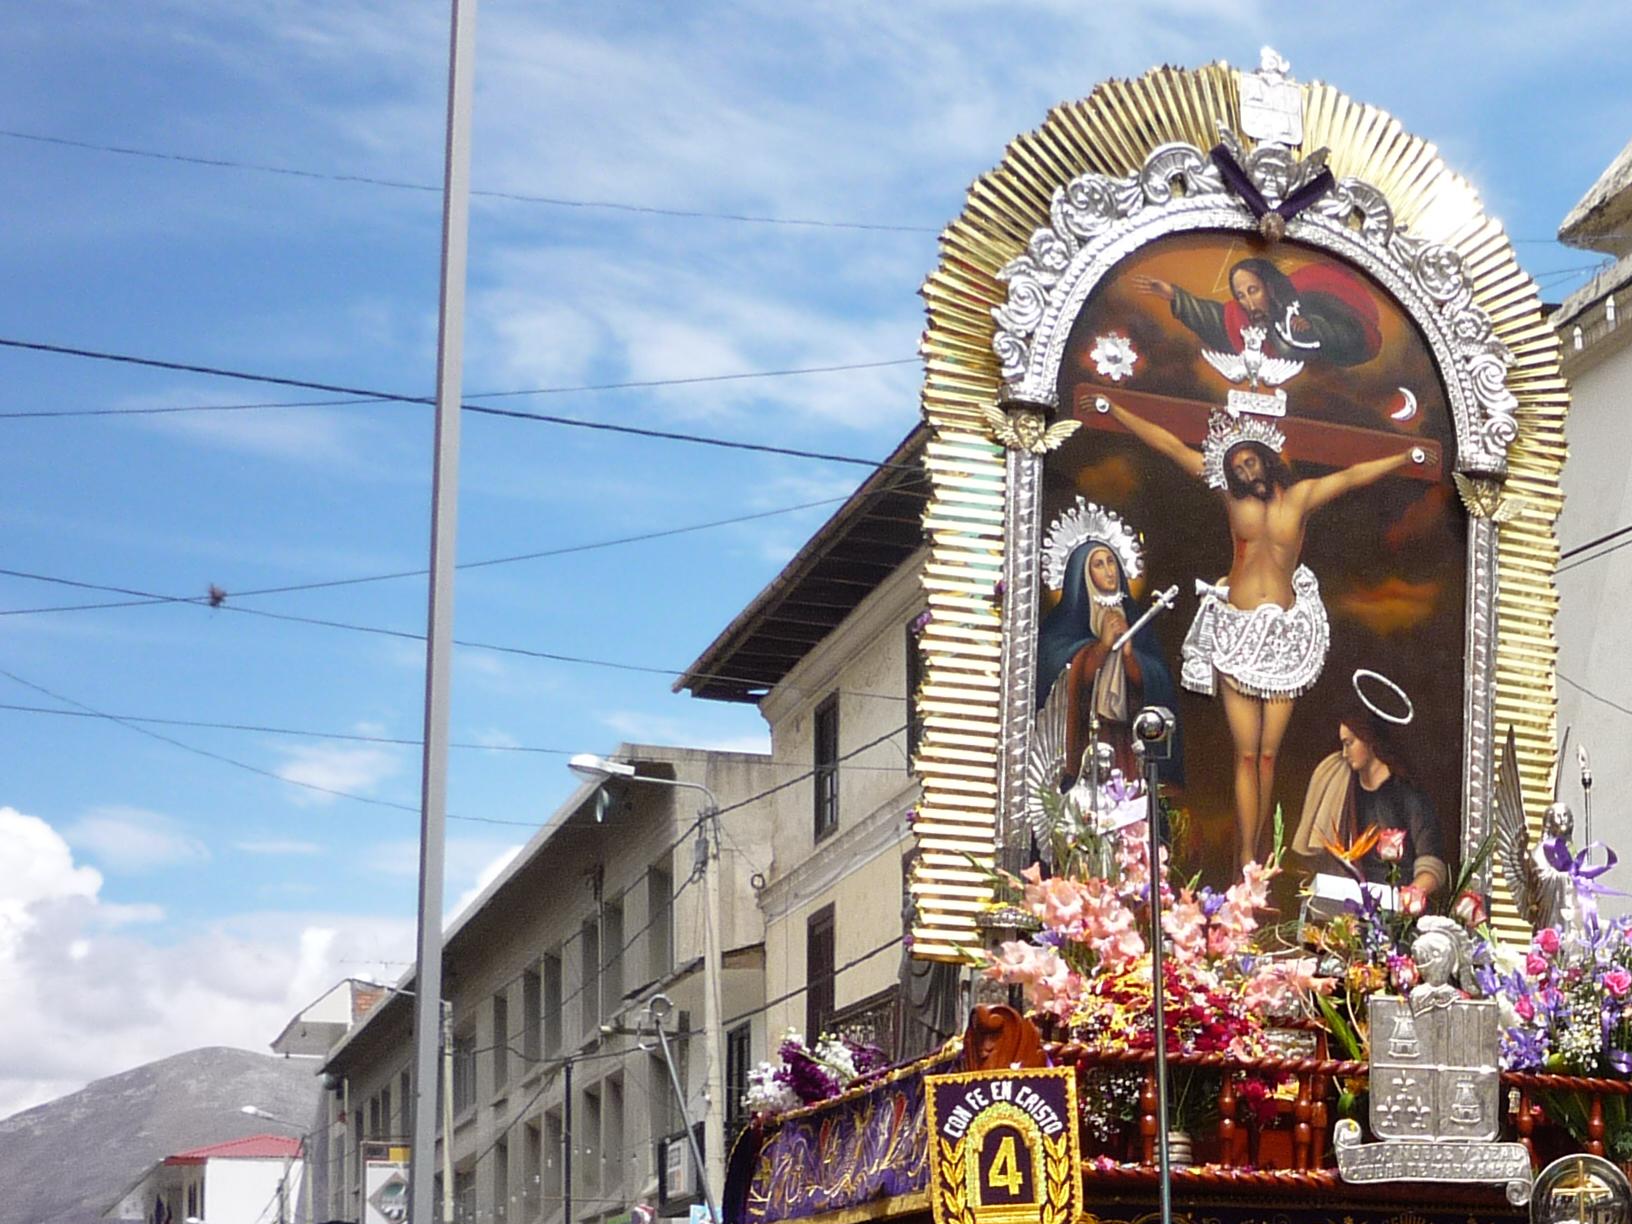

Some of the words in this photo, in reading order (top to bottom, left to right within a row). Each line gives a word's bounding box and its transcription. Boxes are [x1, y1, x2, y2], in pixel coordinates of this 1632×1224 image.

[943, 1105, 973, 1138] CON
[964, 1088, 989, 1110] FE
[990, 1081, 1012, 1101] EN
[1015, 1086, 1063, 1135] CRISTO
[988, 1136, 1024, 1196] 4
